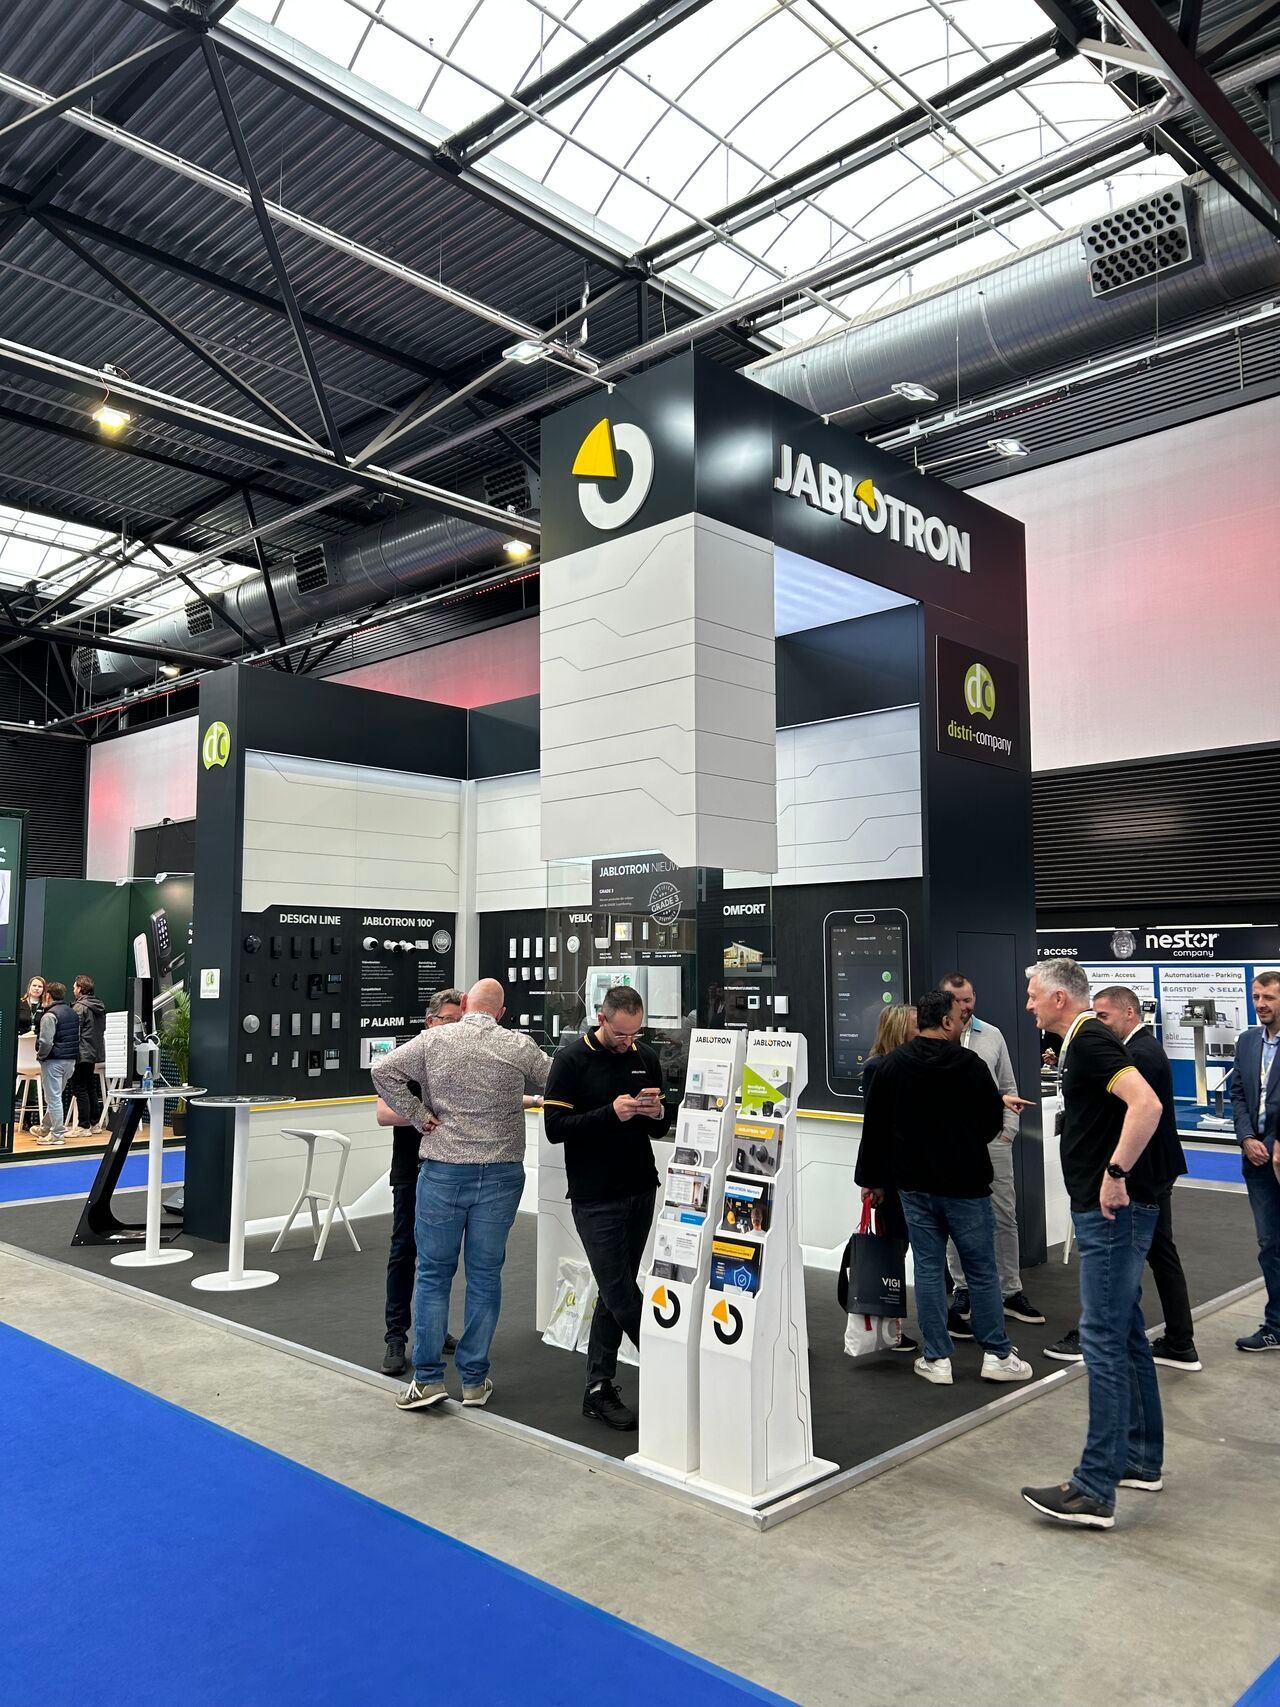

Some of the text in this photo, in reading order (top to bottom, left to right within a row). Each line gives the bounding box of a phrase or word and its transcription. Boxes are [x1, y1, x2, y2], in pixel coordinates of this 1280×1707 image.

[774, 443, 970, 573] JABLOTRON
[948, 719, 1012, 756] distri-company
[599, 863, 649, 877] JABLOTRON
[651, 894, 680, 912] GRADE 3
[723, 903, 766, 916] OMFORT
[279, 913, 341, 925] DESIGN LINE
[362, 916, 416, 927] JABLOTRON
[1145, 930, 1219, 949] nestor
[1043, 948, 1078, 956] access
[1172, 950, 1214, 958] company
[1215, 972, 1242, 980] Parking
[360, 1018, 370, 1028] IP
[371, 1017, 405, 1027] ALARM
[695, 1036, 731, 1045] JABLOTRON
[753, 1039, 792, 1048] JABLOTRON
[881, 1277, 901, 1288] VIGI
